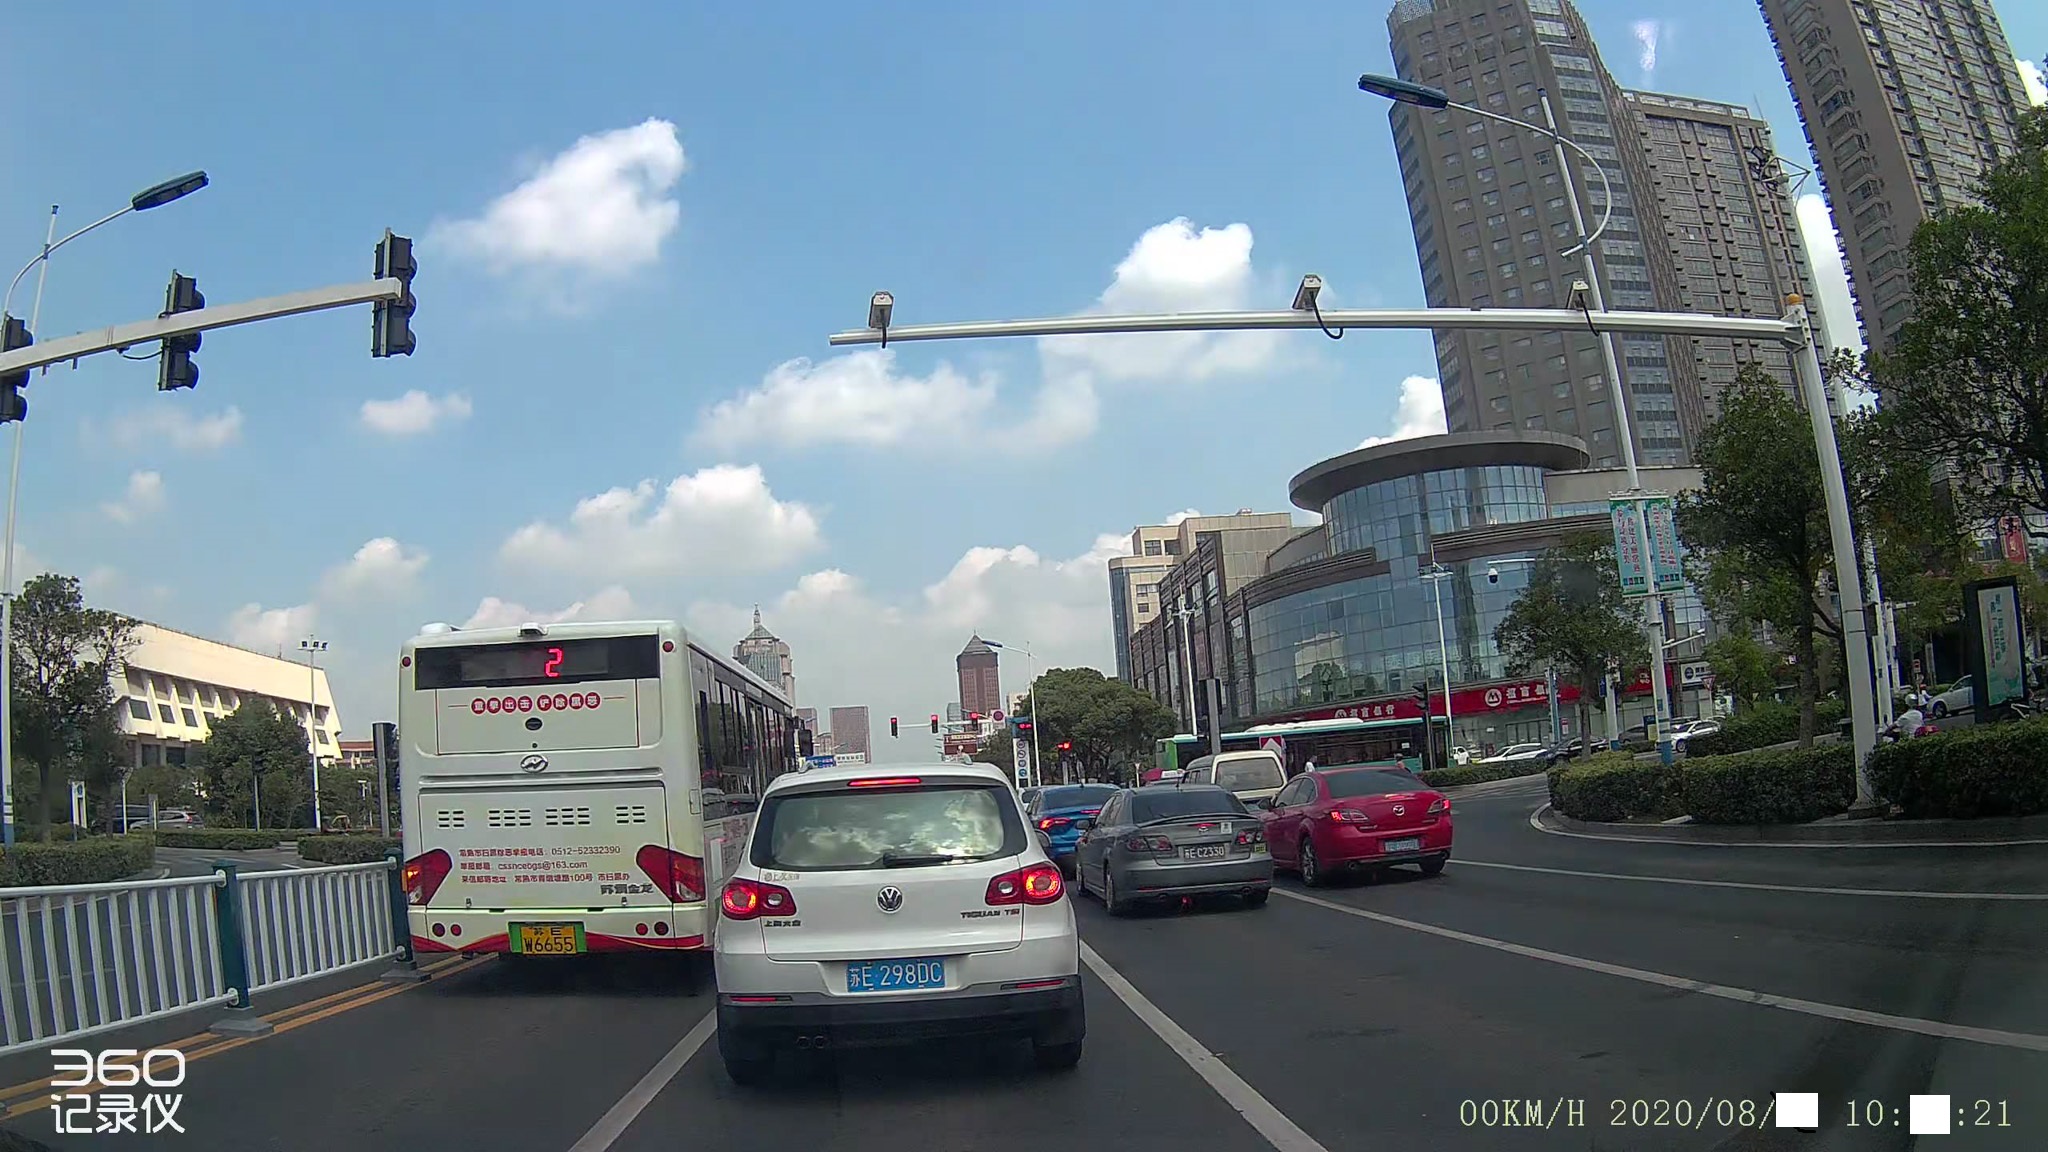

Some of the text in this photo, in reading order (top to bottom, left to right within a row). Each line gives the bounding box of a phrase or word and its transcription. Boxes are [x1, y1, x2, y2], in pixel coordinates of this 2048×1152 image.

[545, 648, 563, 677] 2
[551, 846, 621, 856] 0512-52332390
[960, 910, 1001, 919] TIGUAN
[524, 937, 574, 952] W6655
